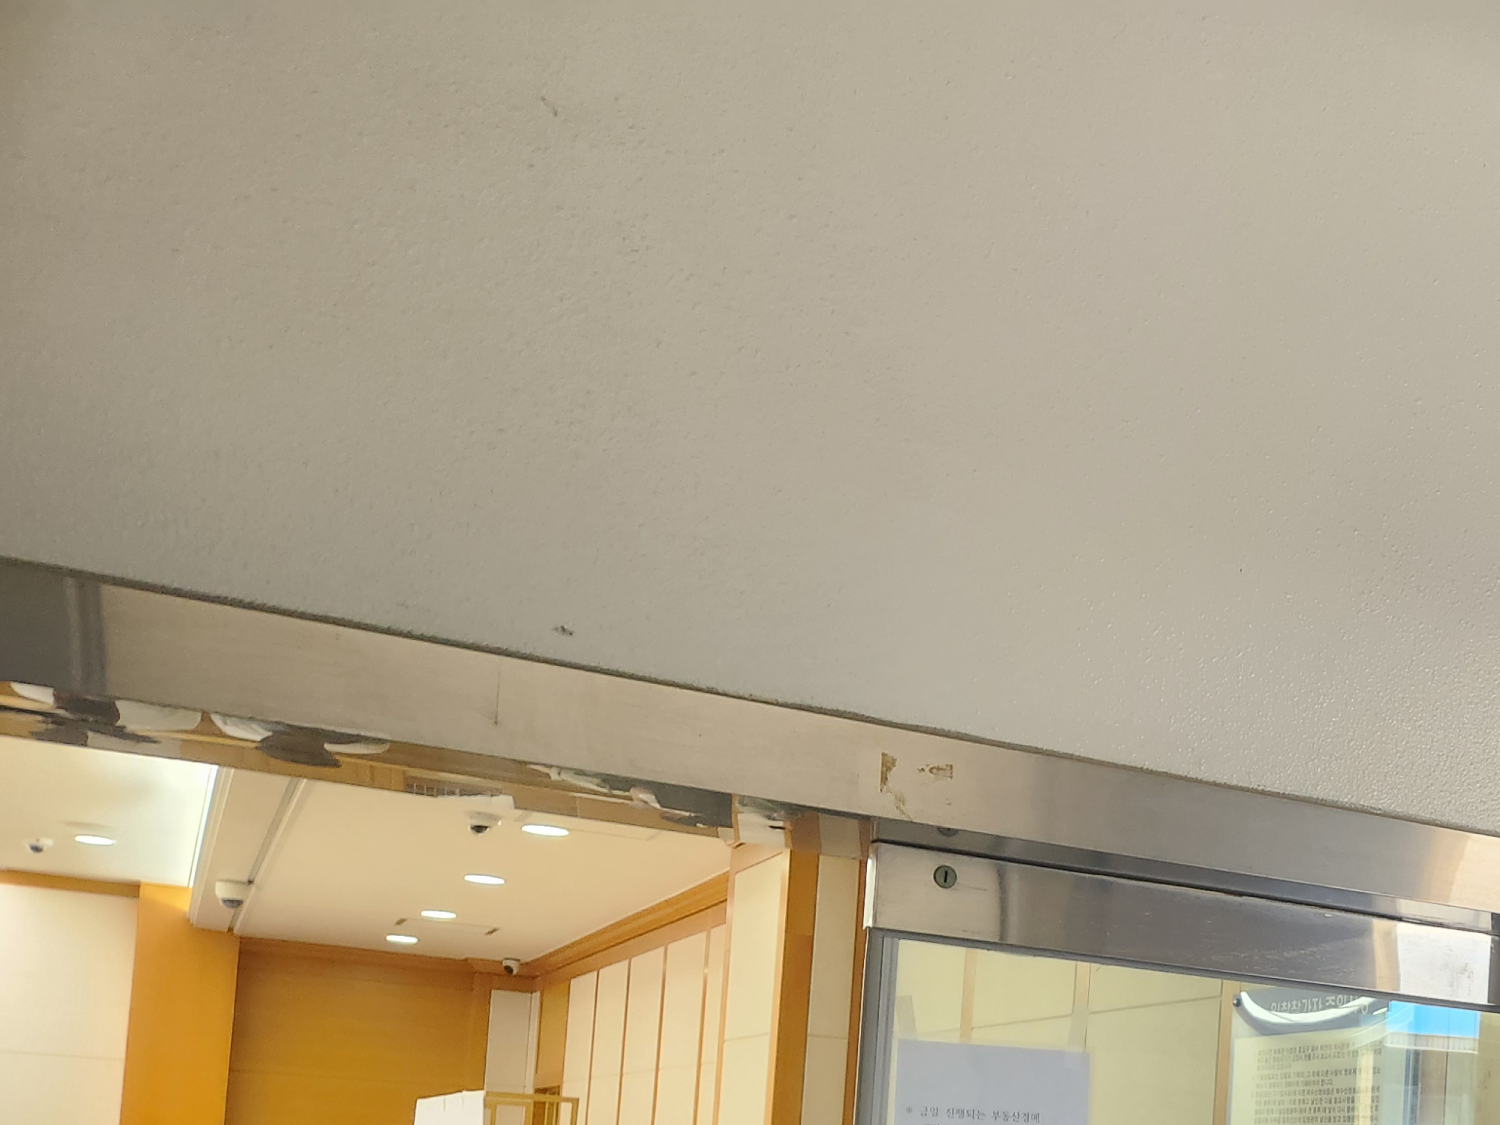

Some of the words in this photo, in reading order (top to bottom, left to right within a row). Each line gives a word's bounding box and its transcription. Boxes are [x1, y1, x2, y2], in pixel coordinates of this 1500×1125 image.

[920, 1106, 939, 1117] 금일
[945, 1107, 986, 1121] 진행되는
[992, 1110, 1040, 1123] 부동산경매
